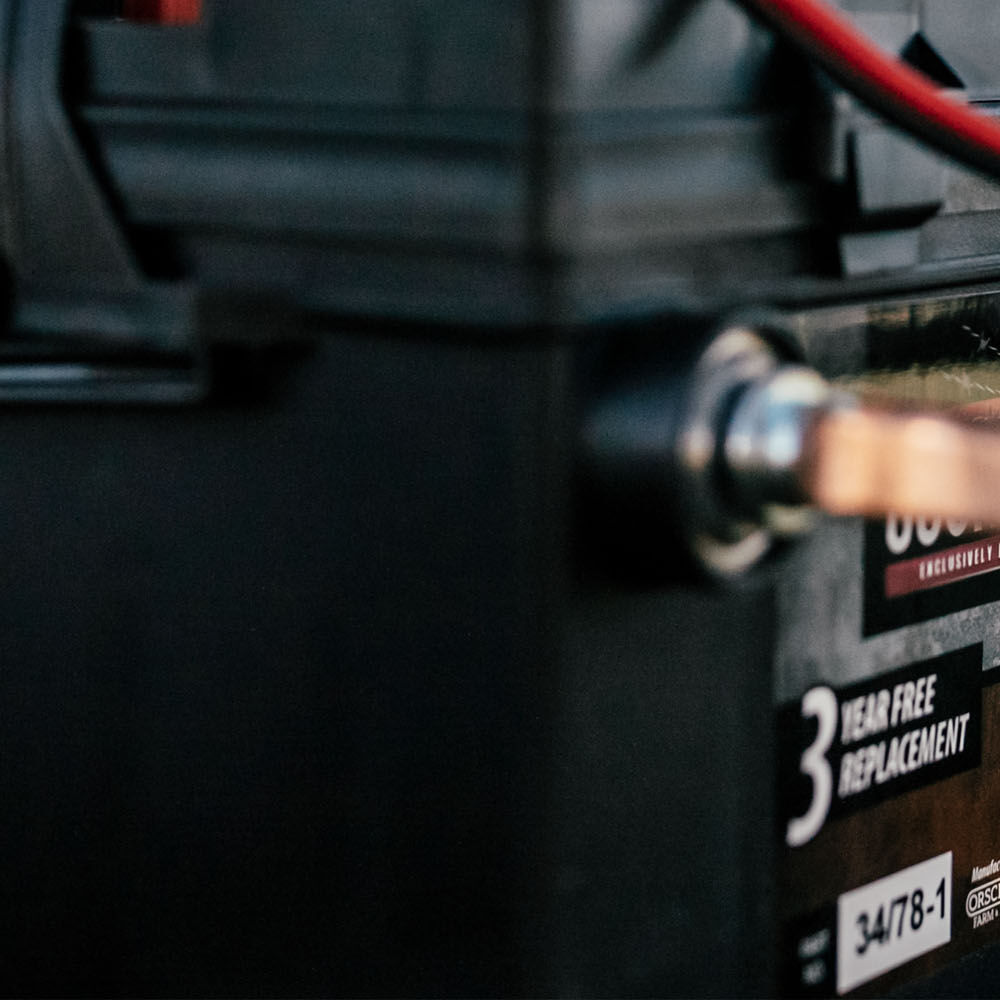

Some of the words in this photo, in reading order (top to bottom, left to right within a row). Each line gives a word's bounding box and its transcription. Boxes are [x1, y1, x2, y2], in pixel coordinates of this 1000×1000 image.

[919, 544, 993, 581] EXCLUSIVELY
[786, 686, 839, 848] 3
[841, 689, 892, 745] YEAR
[890, 673, 938, 727] FREE
[838, 712, 971, 799] REPLACEMENT
[856, 877, 946, 955] 34/78-1
[973, 909, 994, 929] FARM
